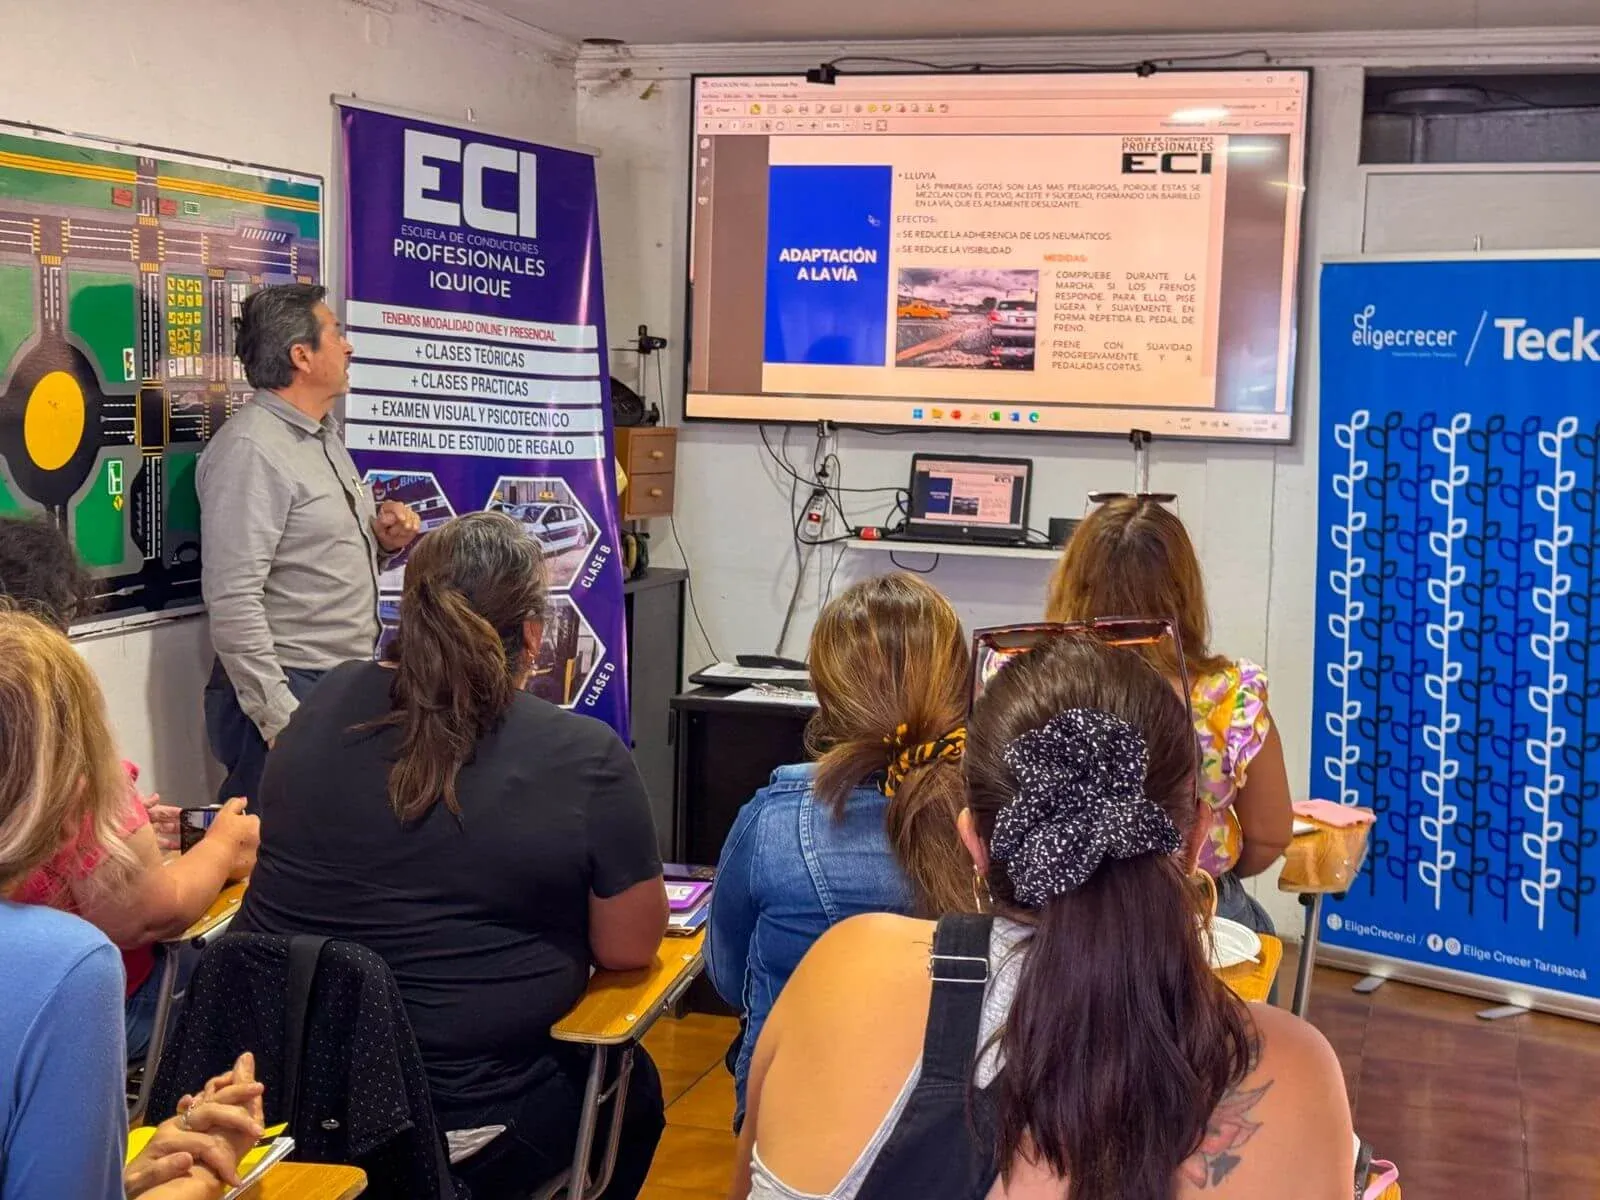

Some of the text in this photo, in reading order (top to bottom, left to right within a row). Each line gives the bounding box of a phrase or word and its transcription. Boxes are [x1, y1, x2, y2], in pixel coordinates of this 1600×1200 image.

[1122, 142, 1214, 152] PROFESIONALES
[1122, 152, 1212, 174] ECI
[403, 128, 537, 240] ECI
[904, 172, 936, 180] LLUVIA
[1096, 192, 1144, 200] FORMANDO
[1123, 184, 1158, 192] PORQUE
[915, 200, 926, 208] EN
[927, 200, 938, 208] LA
[954, 200, 972, 208] QUE
[972, 200, 982, 208] ES
[985, 200, 1029, 208] ALTAMENTE
[400, 224, 539, 256] ESCUELA DE CONDUCTORES
[902, 231, 913, 239] SE
[914, 231, 949, 239] REDUCE
[950, 231, 960, 239] LA
[963, 232, 1018, 240] ADHERENCIA
[1020, 232, 1032, 240] DE
[1034, 232, 1050, 240] LOS
[394, 238, 546, 278] PROFESIONALES
[779, 246, 877, 264] ADAPTACIÓN
[962, 246, 1012, 254] VISIBILIDAD
[797, 266, 858, 282] A LA VÍA
[1056, 271, 1196, 281] COMPRUEBE DURANTE LA
[430, 270, 512, 300] IQUIQUE
[1056, 282, 1196, 292] MARCHA SI LOS FRENOS
[1112, 293, 1136, 301] PARA
[1176, 294, 1196, 303] PISE
[1054, 303, 1195, 313] LIGERA Y SUAVEMENTE EN
[382, 311, 557, 342] TENEMOS MODALIDAD ONLINE Y PRESENCIAL
[1054, 313, 1194, 324] FORMA REPETIDA EL PEDAL DE
[1052, 340, 1193, 352] FRENE CON SUAVIDAD
[1352, 316, 1600, 362] eligecrecer Teck
[425, 343, 472, 363] CLASES
[474, 346, 525, 368] TEÓRICAS
[1052, 351, 1139, 361] PROGRESIVAMENTE
[1052, 361, 1105, 370] PEDALADAS
[421, 372, 468, 392] CLASES
[472, 377, 529, 398] PRACTICAS
[382, 400, 430, 420] EXAMEN
[433, 404, 478, 424] VISUAL
[478, 407, 484, 422] Y
[488, 408, 570, 428] PSICOTECNICO
[378, 430, 436, 450] MATERIAL
[439, 434, 456, 451] DE
[459, 435, 506, 454] ESTUDIO
[508, 438, 523, 454] DE
[526, 438, 575, 456] REGALO
[581, 544, 612, 589] CLASE B
[584, 662, 616, 707] CLASE D
[1345, 920, 1416, 944] EligeCrecer.cl
[1464, 944, 1492, 961] Elige
[1494, 950, 1531, 969] Crecer
[1534, 958, 1588, 981] Tarapacá
